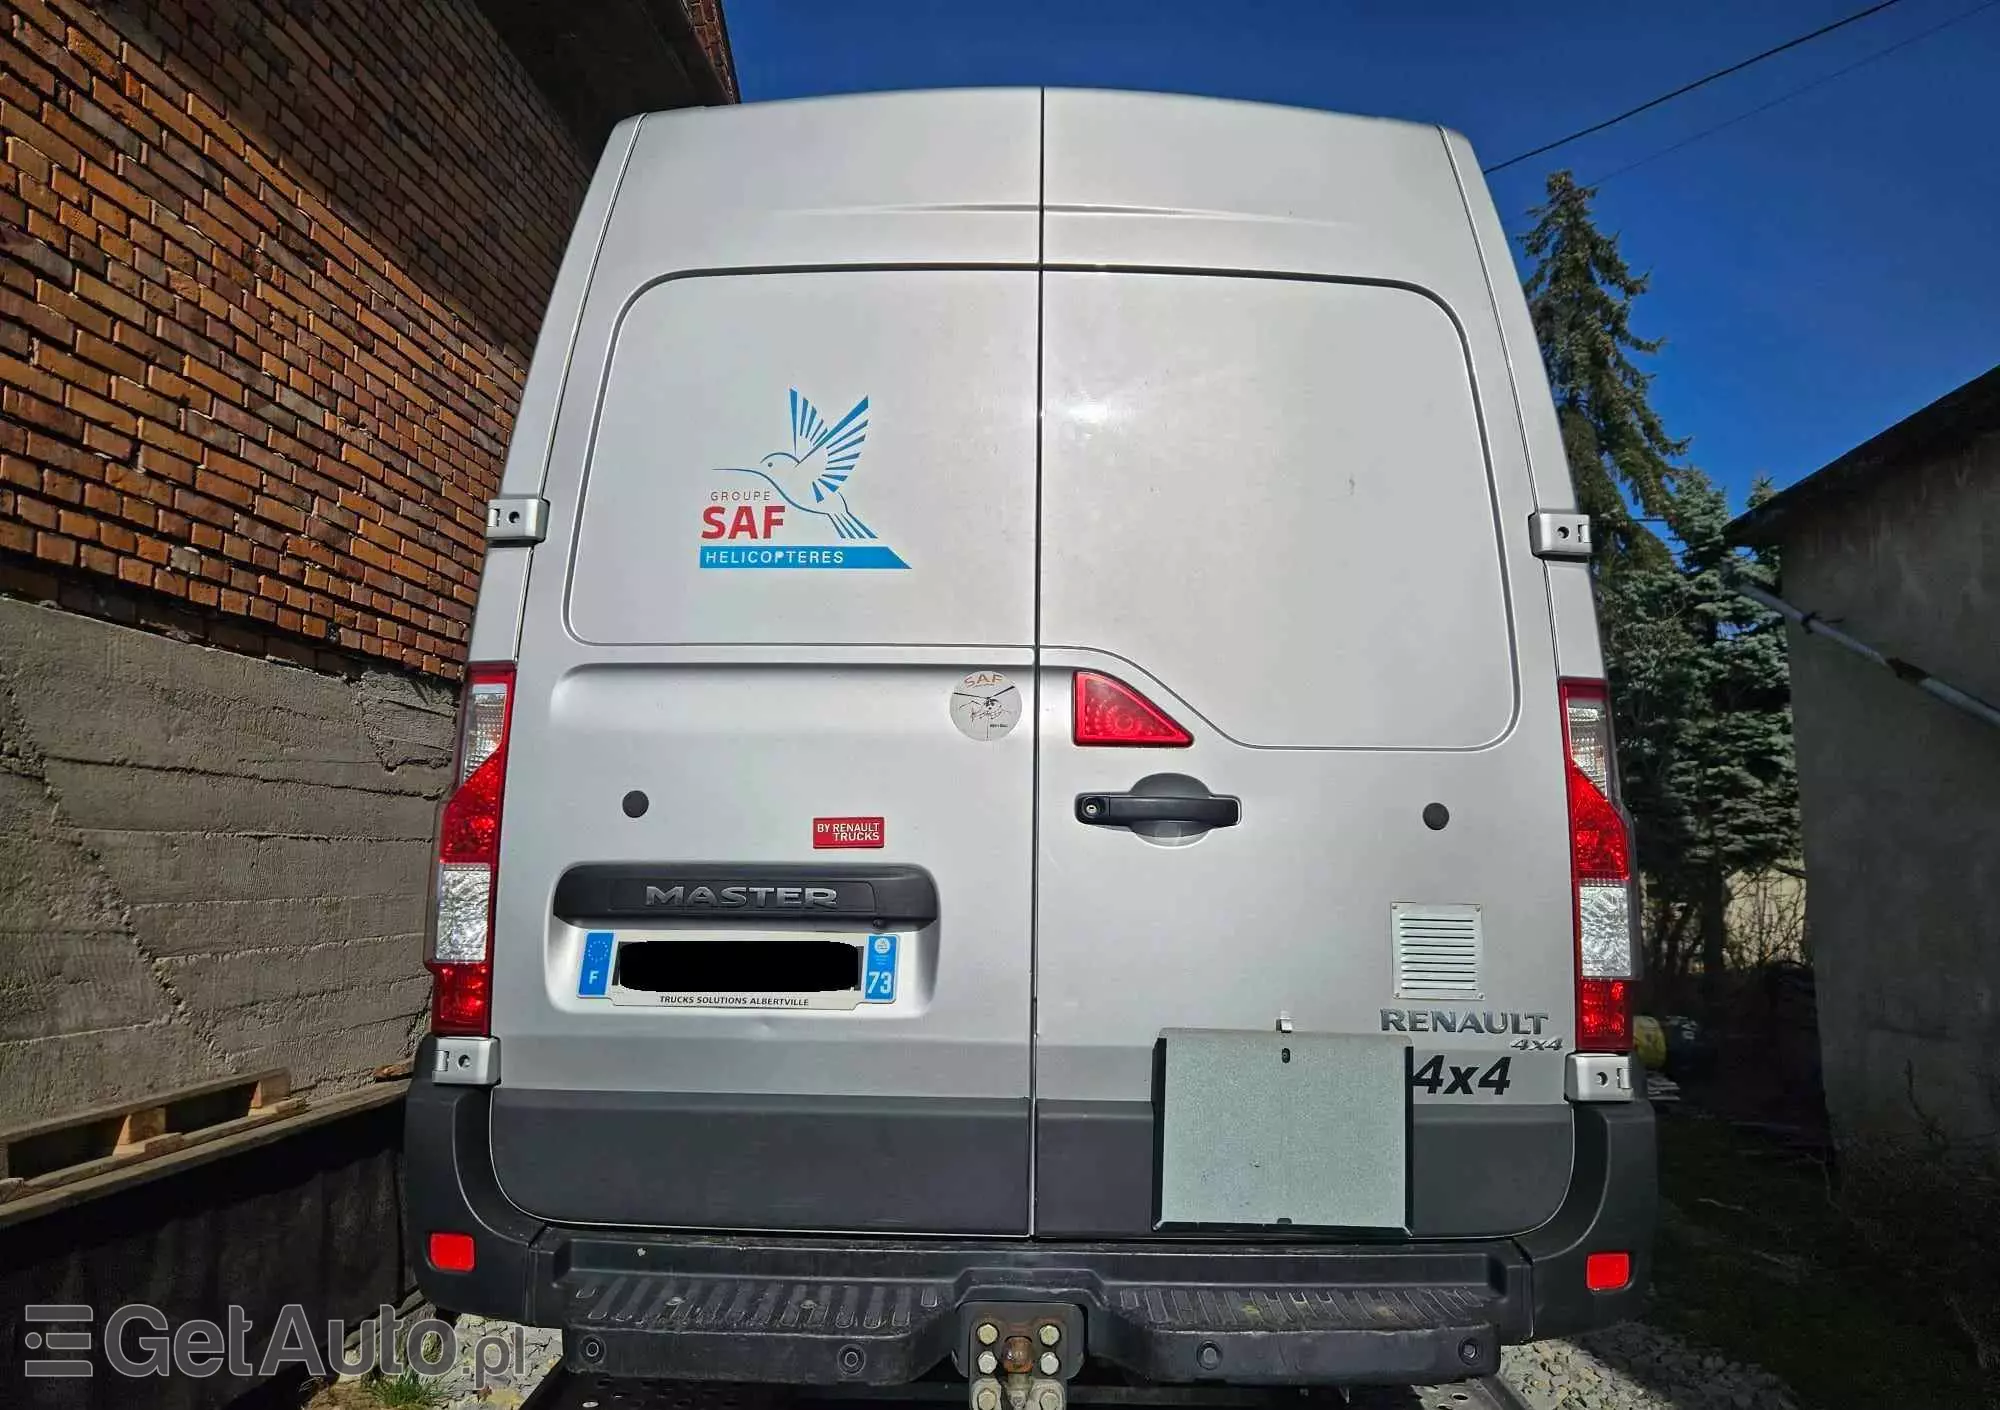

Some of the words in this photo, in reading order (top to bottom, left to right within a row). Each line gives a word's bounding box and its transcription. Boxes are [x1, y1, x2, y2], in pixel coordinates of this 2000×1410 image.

[710, 491, 771, 501] GROUPE
[701, 505, 786, 540] SAF
[705, 551, 844, 564] HELICOPTERES
[964, 673, 1003, 689] SAF
[817, 823, 831, 833] BY
[832, 822, 880, 833] RENAULT
[832, 831, 880, 842] TRUCKS
[645, 886, 837, 909] MASTER
[588, 970, 599, 985] F
[867, 971, 892, 994] 73
[660, 995, 695, 1004] TRUCKS
[697, 996, 747, 1005] SOLUTIONS
[749, 997, 809, 1007] ALBERTVILLE
[1379, 1007, 1549, 1036] RENAULT
[1511, 1037, 1565, 1051] 4x4
[1411, 1054, 1512, 1096] 4x4
